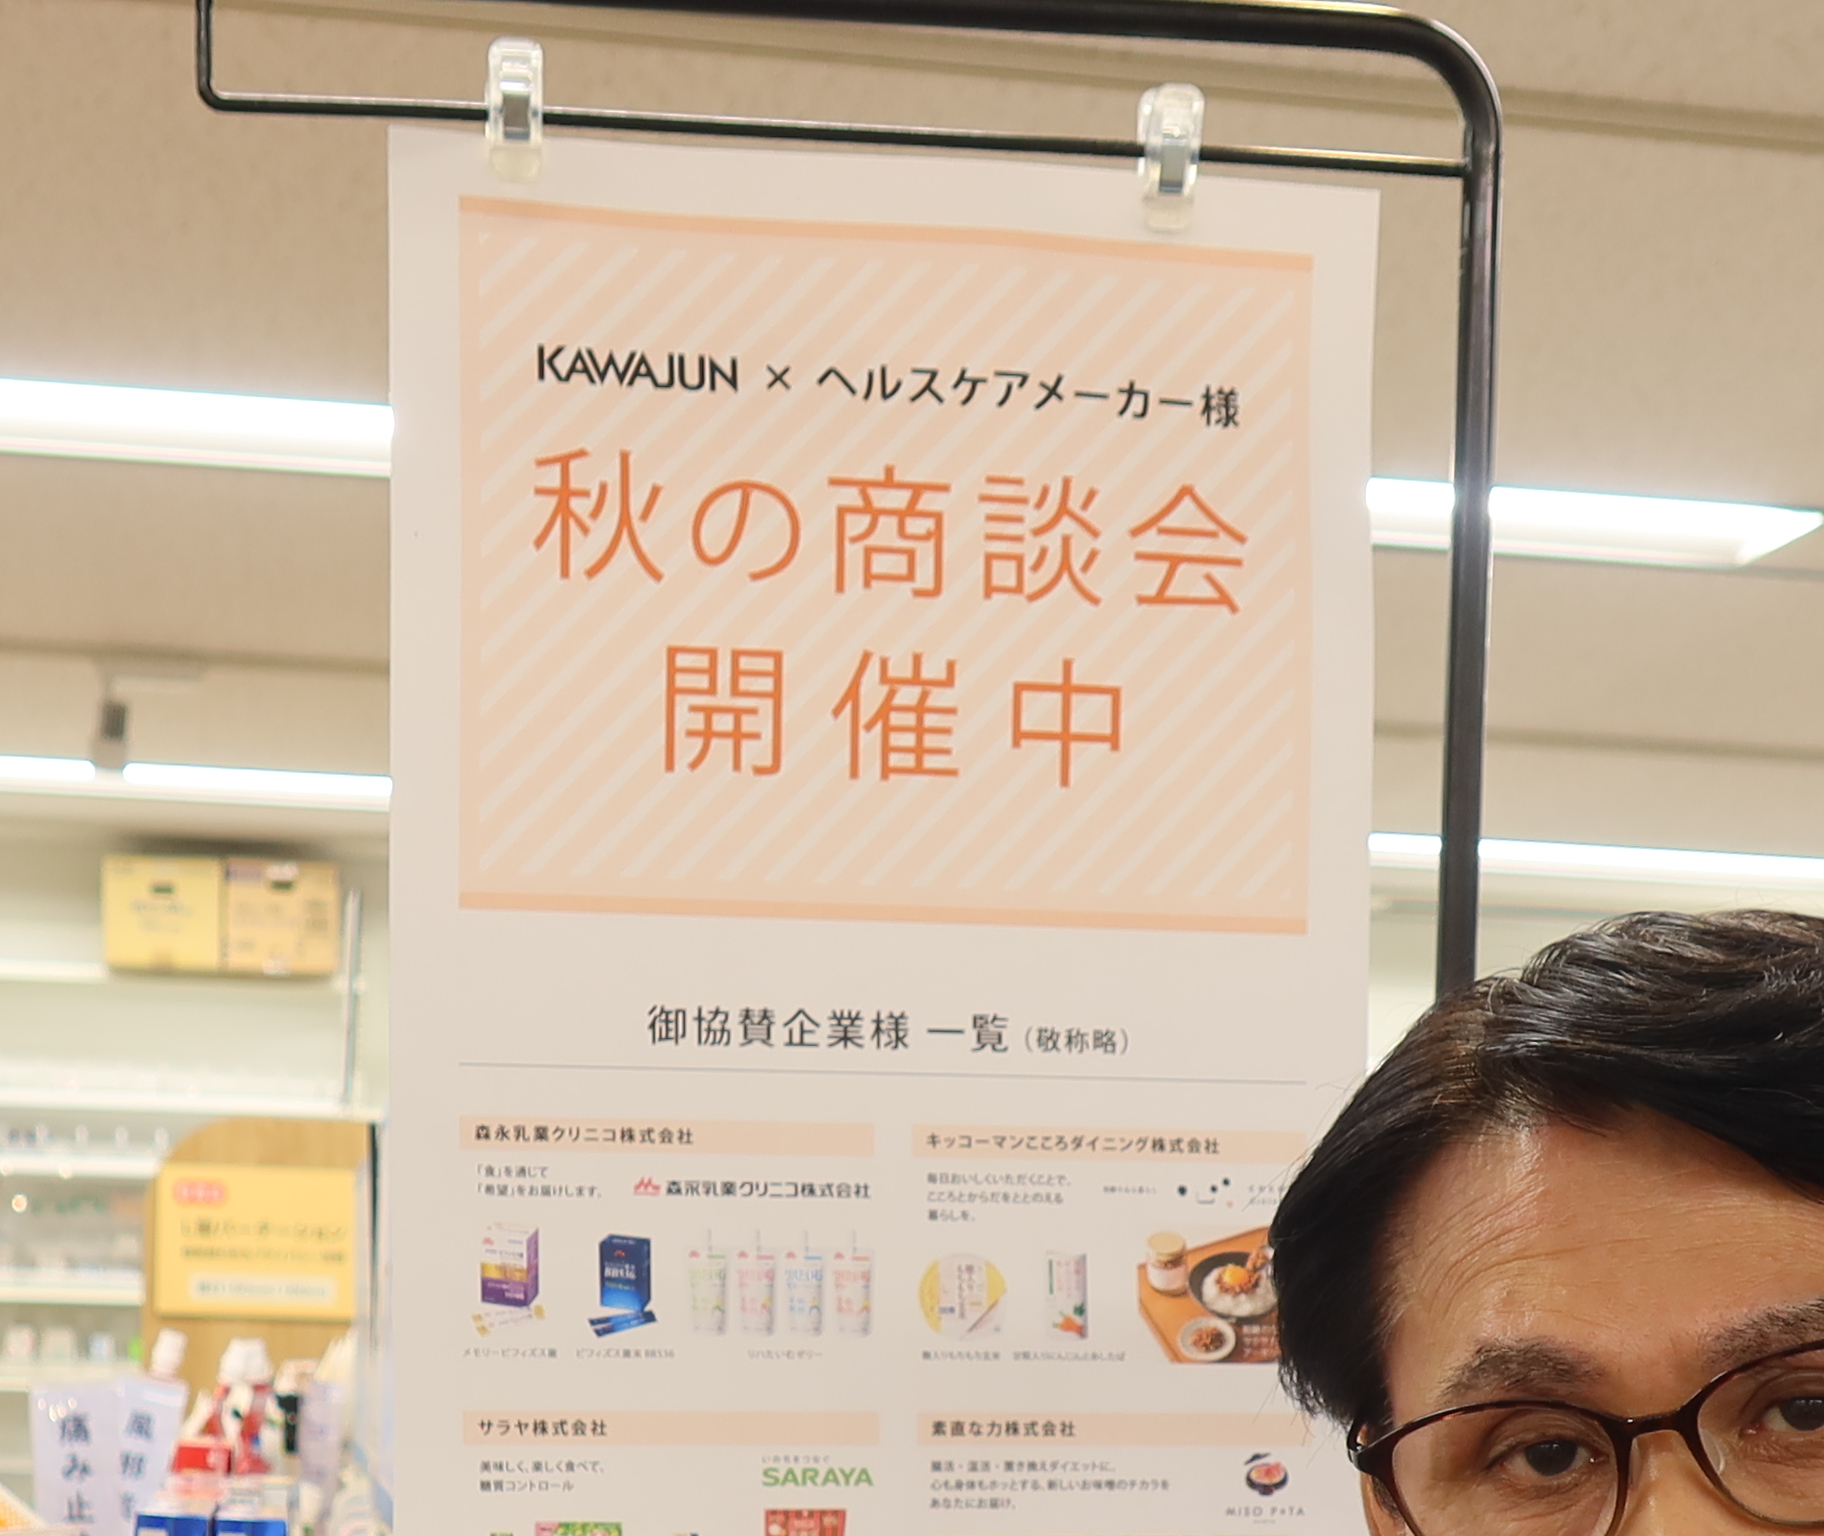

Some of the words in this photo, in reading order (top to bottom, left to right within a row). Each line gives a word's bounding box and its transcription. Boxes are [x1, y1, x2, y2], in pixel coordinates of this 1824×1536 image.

[536, 344, 739, 393] KAWAJUN
[816, 362, 1241, 429] ヘルスケアメーカー様
[532, 447, 1248, 616] 秋の商談会
[661, 644, 1124, 788] 開催中
[647, 1003, 911, 1052] 御協賛企業様
[926, 1012, 1009, 1055] 一覧
[474, 1124, 694, 1145] 森永乳業クリニコ株式会社
[926, 1132, 1220, 1155] キッコーマンこころダイニング株式会社
[665, 1180, 871, 1199] 森永乳業クリニコ株式会社
[478, 1419, 608, 1437] サラヤ株式会社
[931, 1420, 1076, 1438] 素直な力株式会社
[762, 1467, 874, 1488] SARAYA
